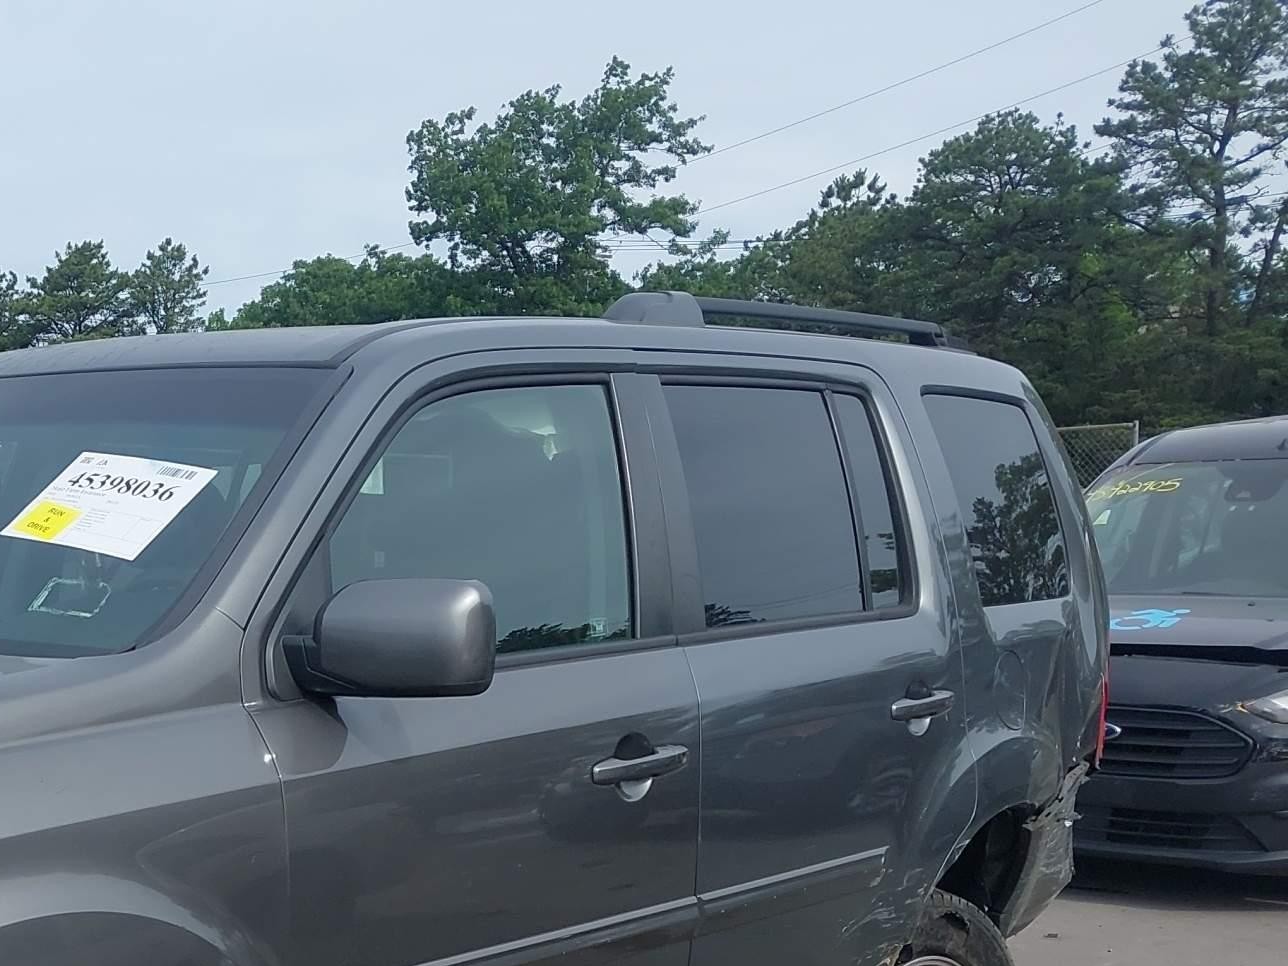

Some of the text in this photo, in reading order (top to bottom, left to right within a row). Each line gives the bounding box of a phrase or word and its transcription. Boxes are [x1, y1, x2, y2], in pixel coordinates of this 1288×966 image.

[67, 472, 181, 501] 45398036
[47, 507, 66, 517] RUN
[26, 521, 51, 533] DRIVE
